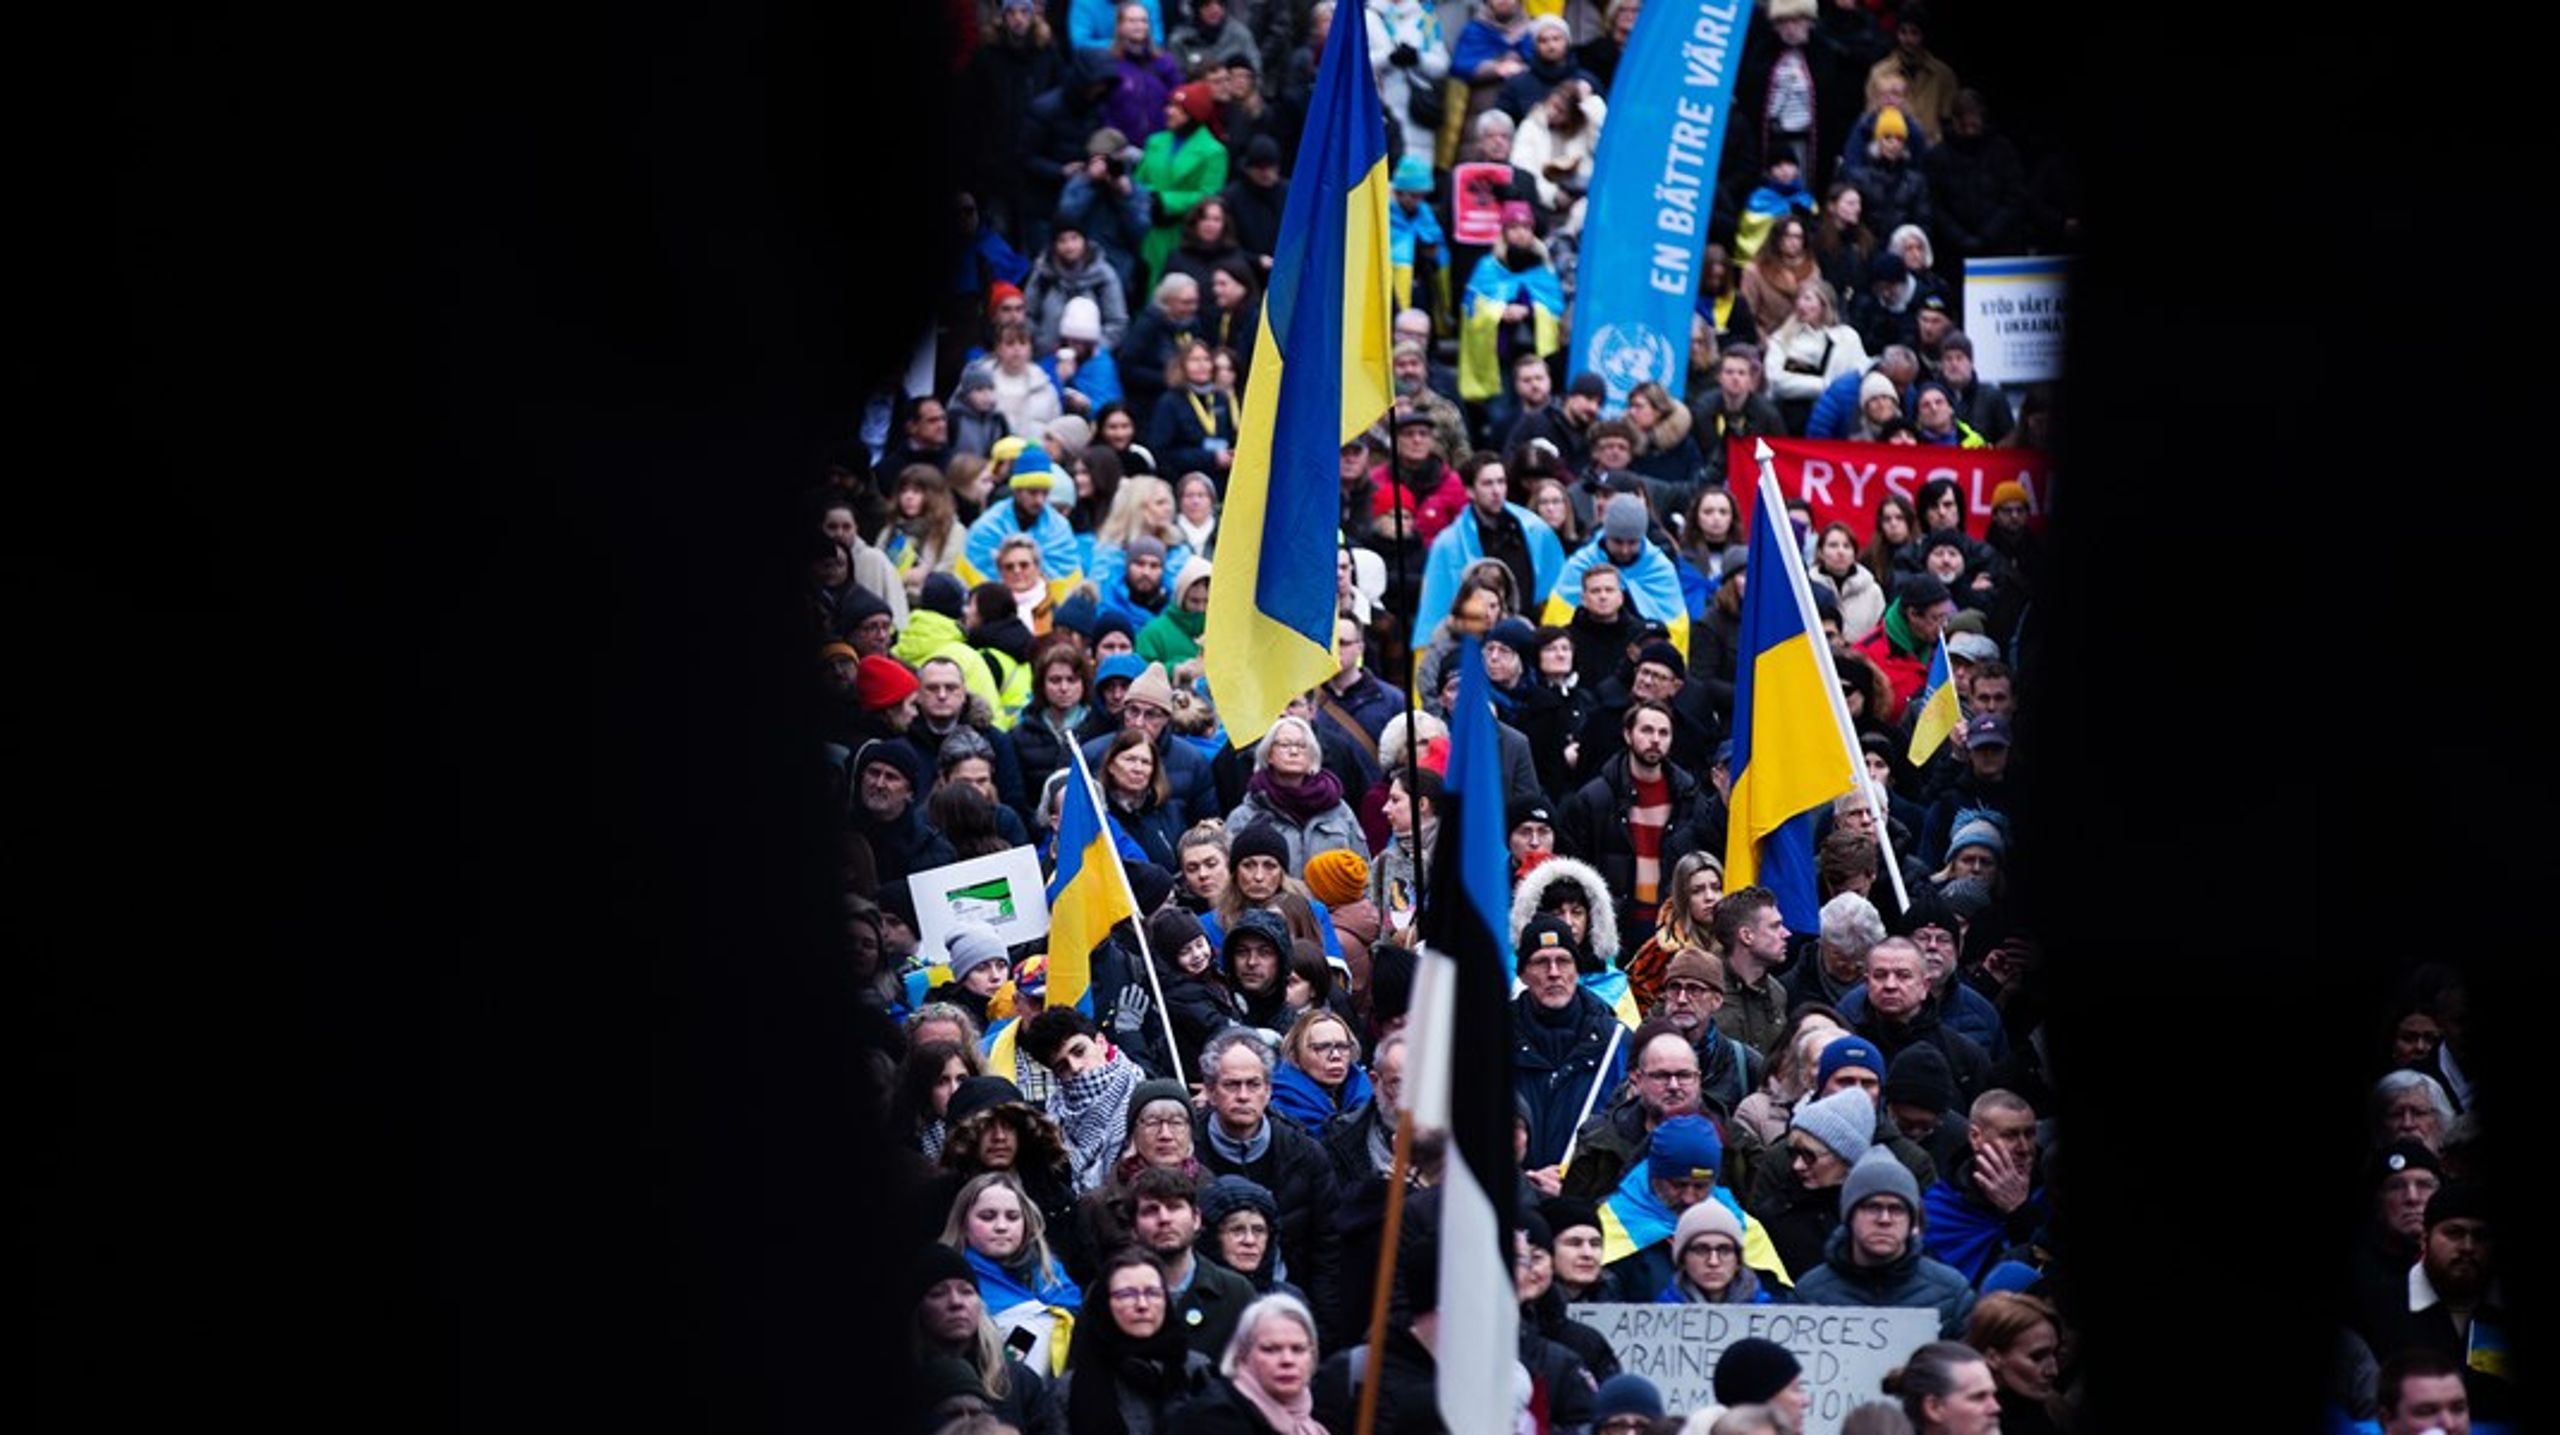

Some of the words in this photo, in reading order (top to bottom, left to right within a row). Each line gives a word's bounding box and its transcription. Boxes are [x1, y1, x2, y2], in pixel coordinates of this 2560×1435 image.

[1681, 0, 1737, 86] VÄRL
[1654, 96, 1714, 236] BÄTTRE
[1650, 242, 1691, 295] EN
[1610, 1309, 1728, 1343] ARMED
[1749, 1314, 1889, 1350] FORCES
